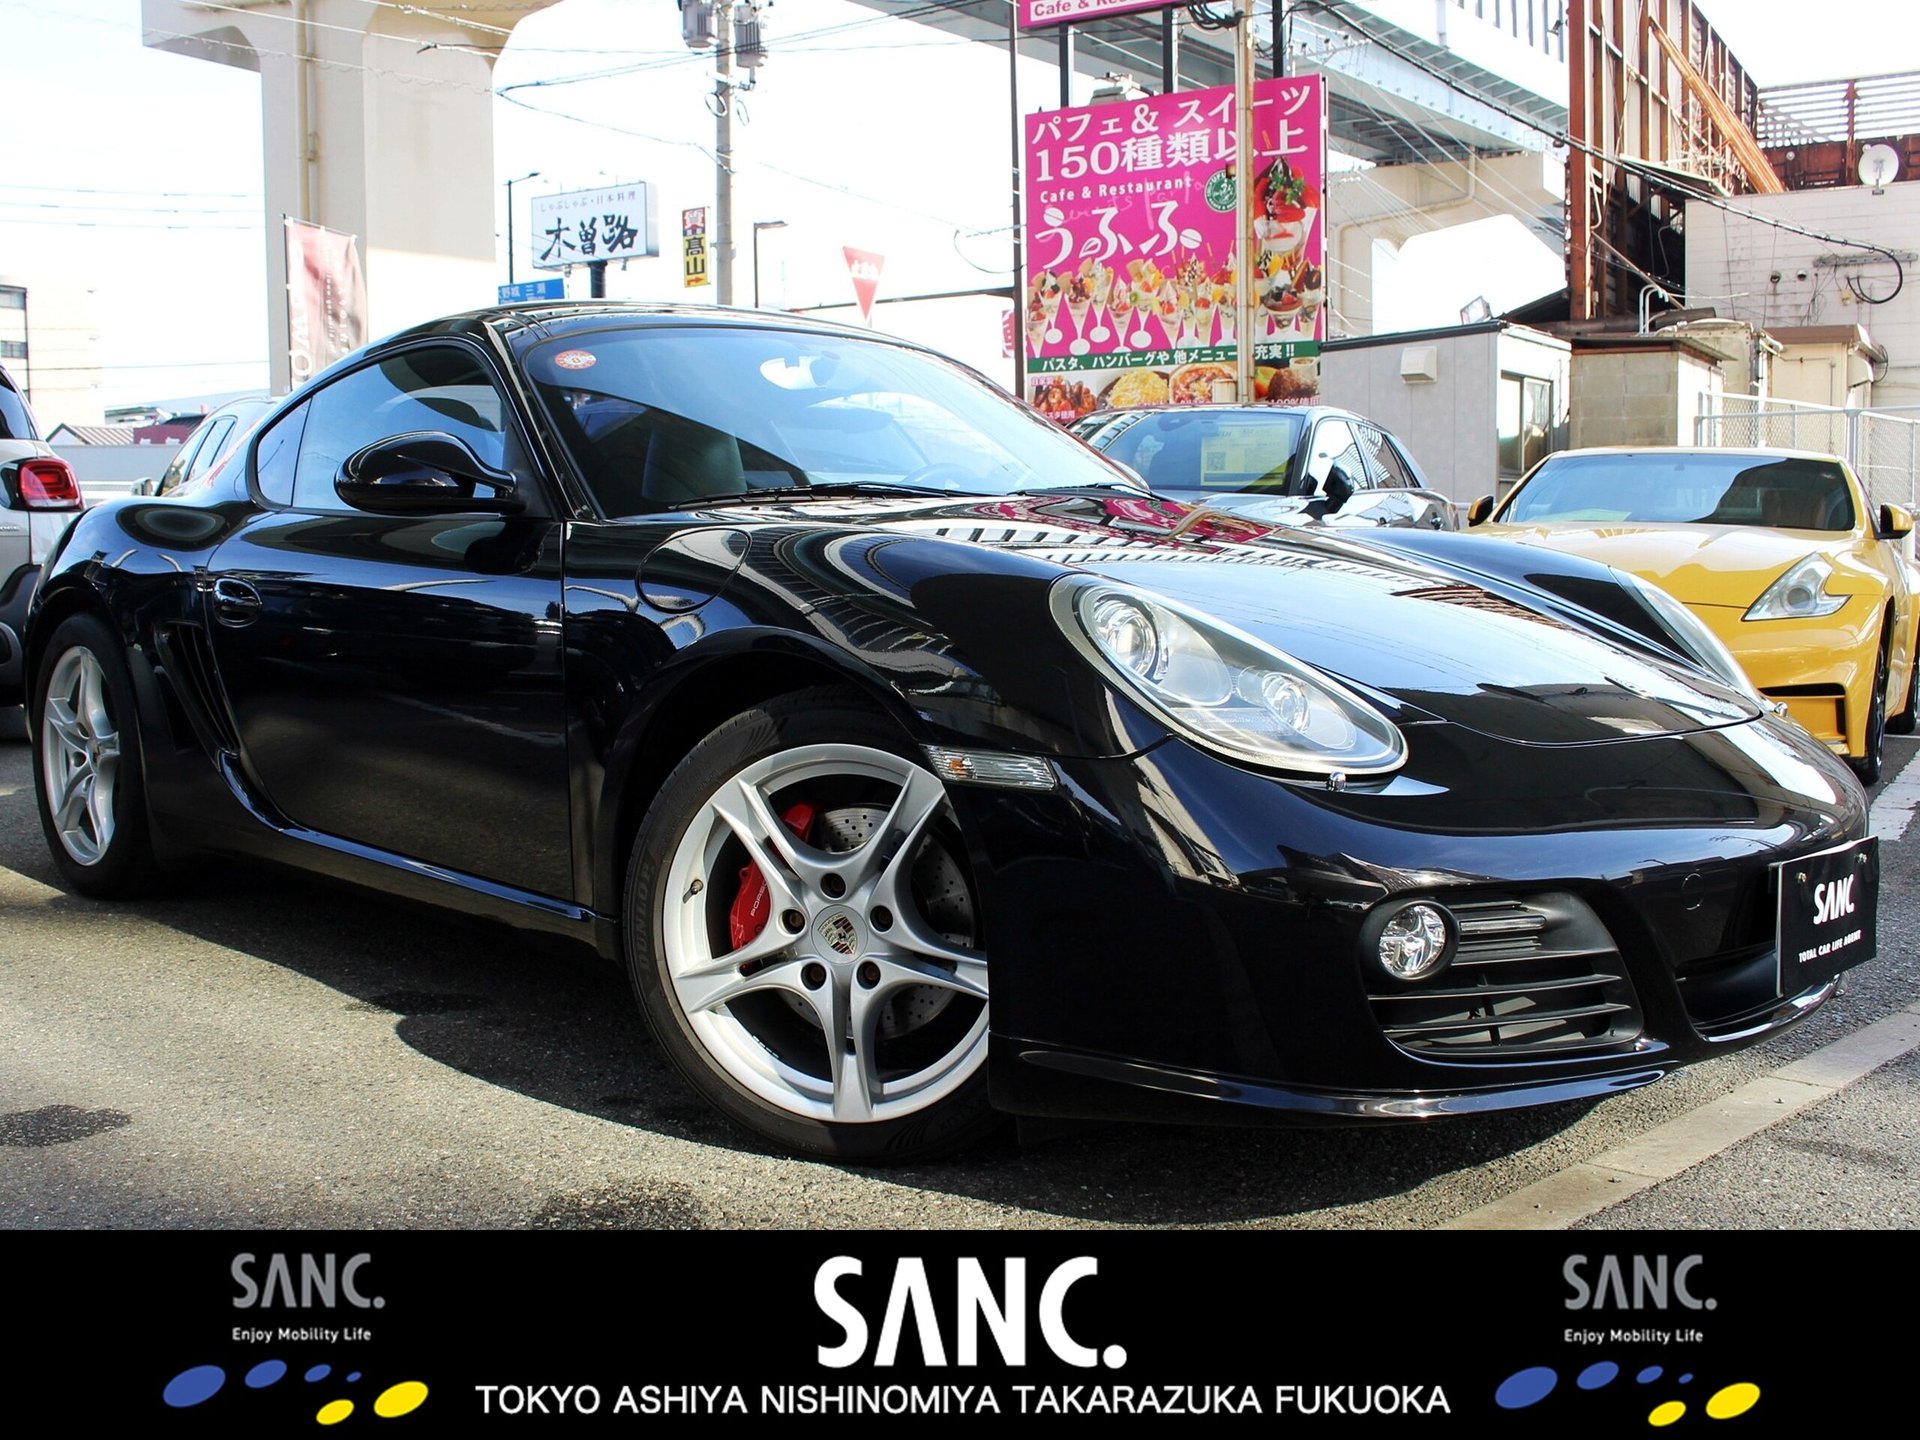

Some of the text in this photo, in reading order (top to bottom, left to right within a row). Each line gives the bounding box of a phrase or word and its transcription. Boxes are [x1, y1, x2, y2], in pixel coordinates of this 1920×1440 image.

[1034, 1, 1071, 17] Cafe
[1173, 85, 1311, 128] スイーツ
[1036, 119, 1308, 183] 150種類以上
[1039, 176, 1192, 204] Cafe & Restaurant
[540, 214, 639, 261] 木曽路
[686, 236, 705, 276] 高山
[1035, 200, 1203, 270] うふふ
[636, 863, 651, 970] DUNLOP
[1798, 929, 1862, 963] TOTAL CAR LIFE AGENT
